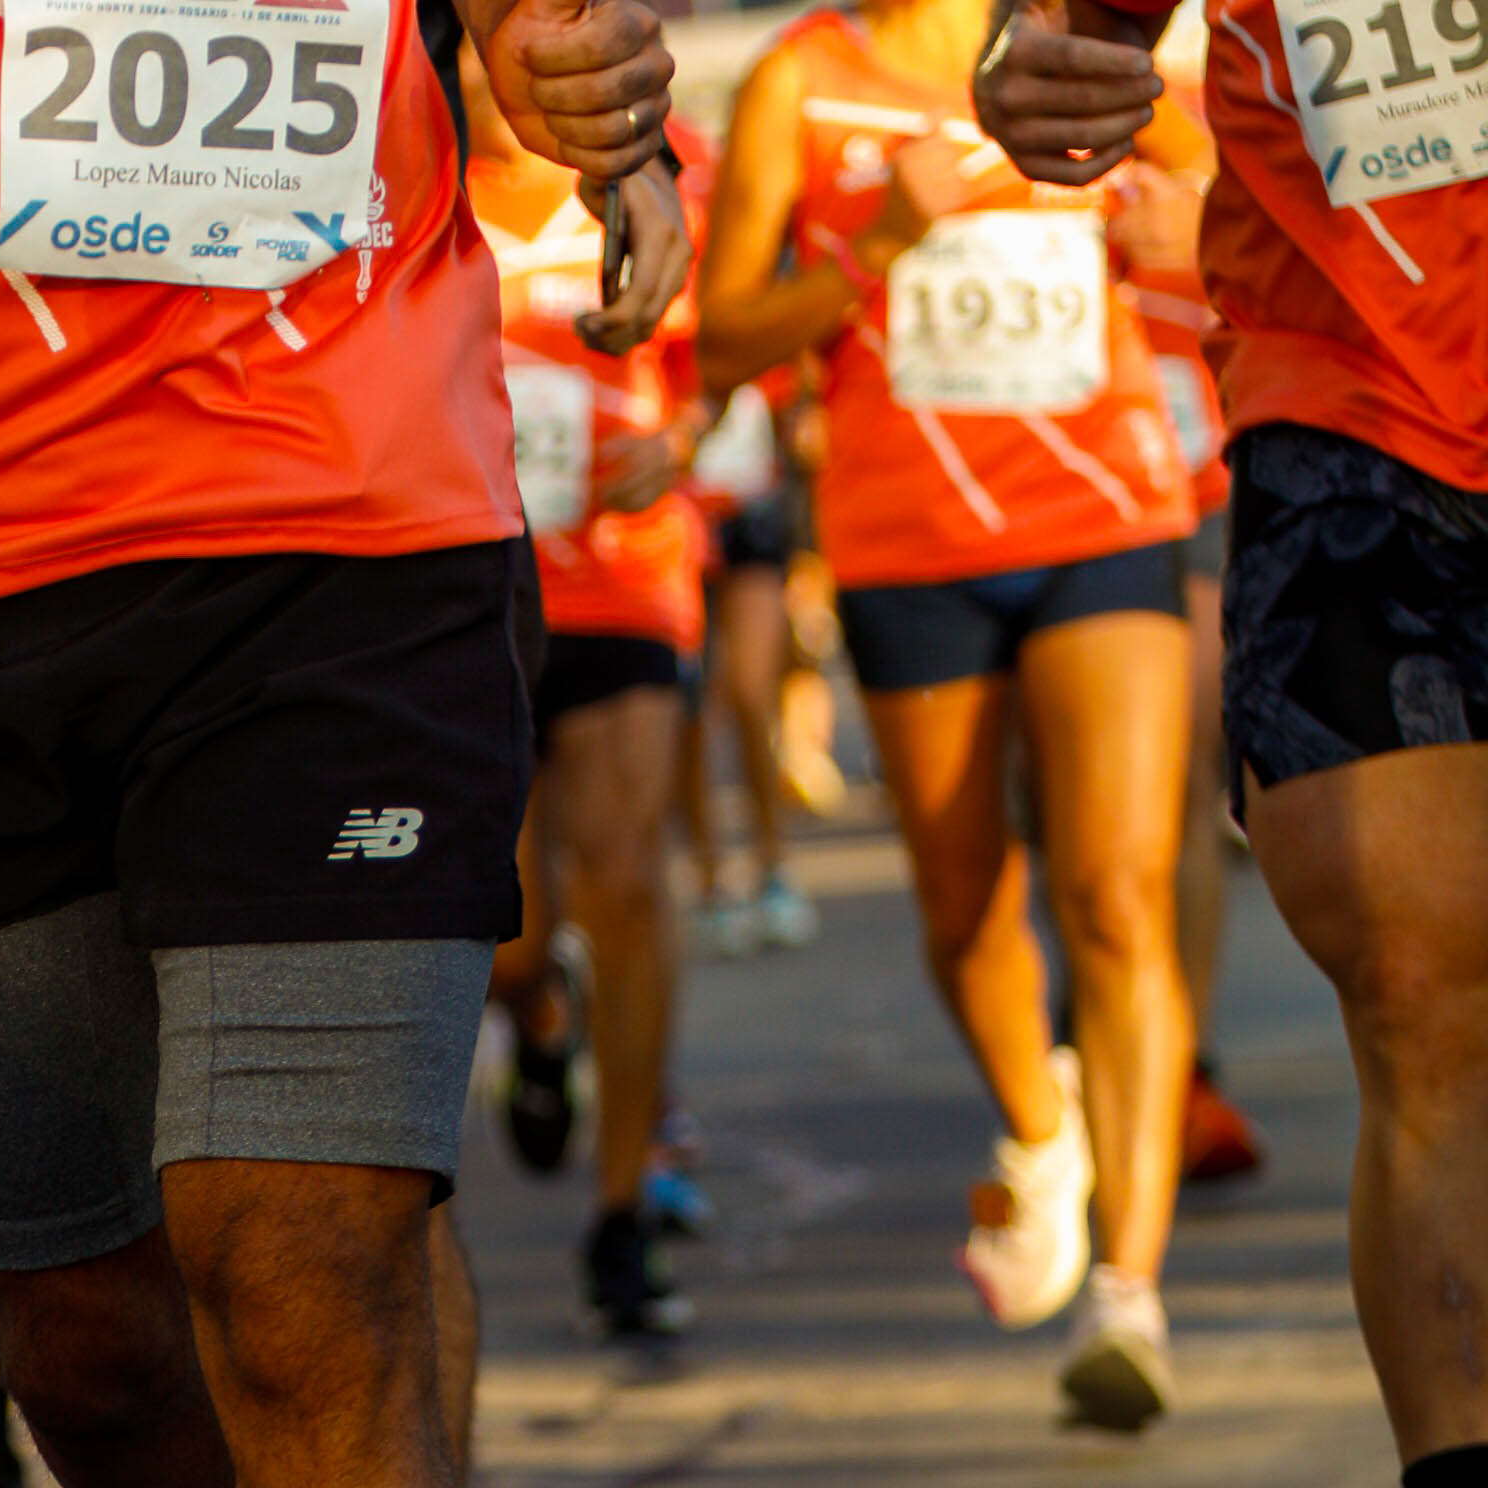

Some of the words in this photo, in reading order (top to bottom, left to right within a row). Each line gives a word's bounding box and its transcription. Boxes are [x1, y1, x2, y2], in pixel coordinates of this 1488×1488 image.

[19, 26, 364, 156] 2025
[74, 159, 140, 188] Lopez
[147, 163, 217, 187] Mauro
[223, 166, 302, 191] Nicolas
[1361, 134, 1454, 178] osde
[51, 211, 170, 258] osde
[907, 277, 1086, 342] 1939
